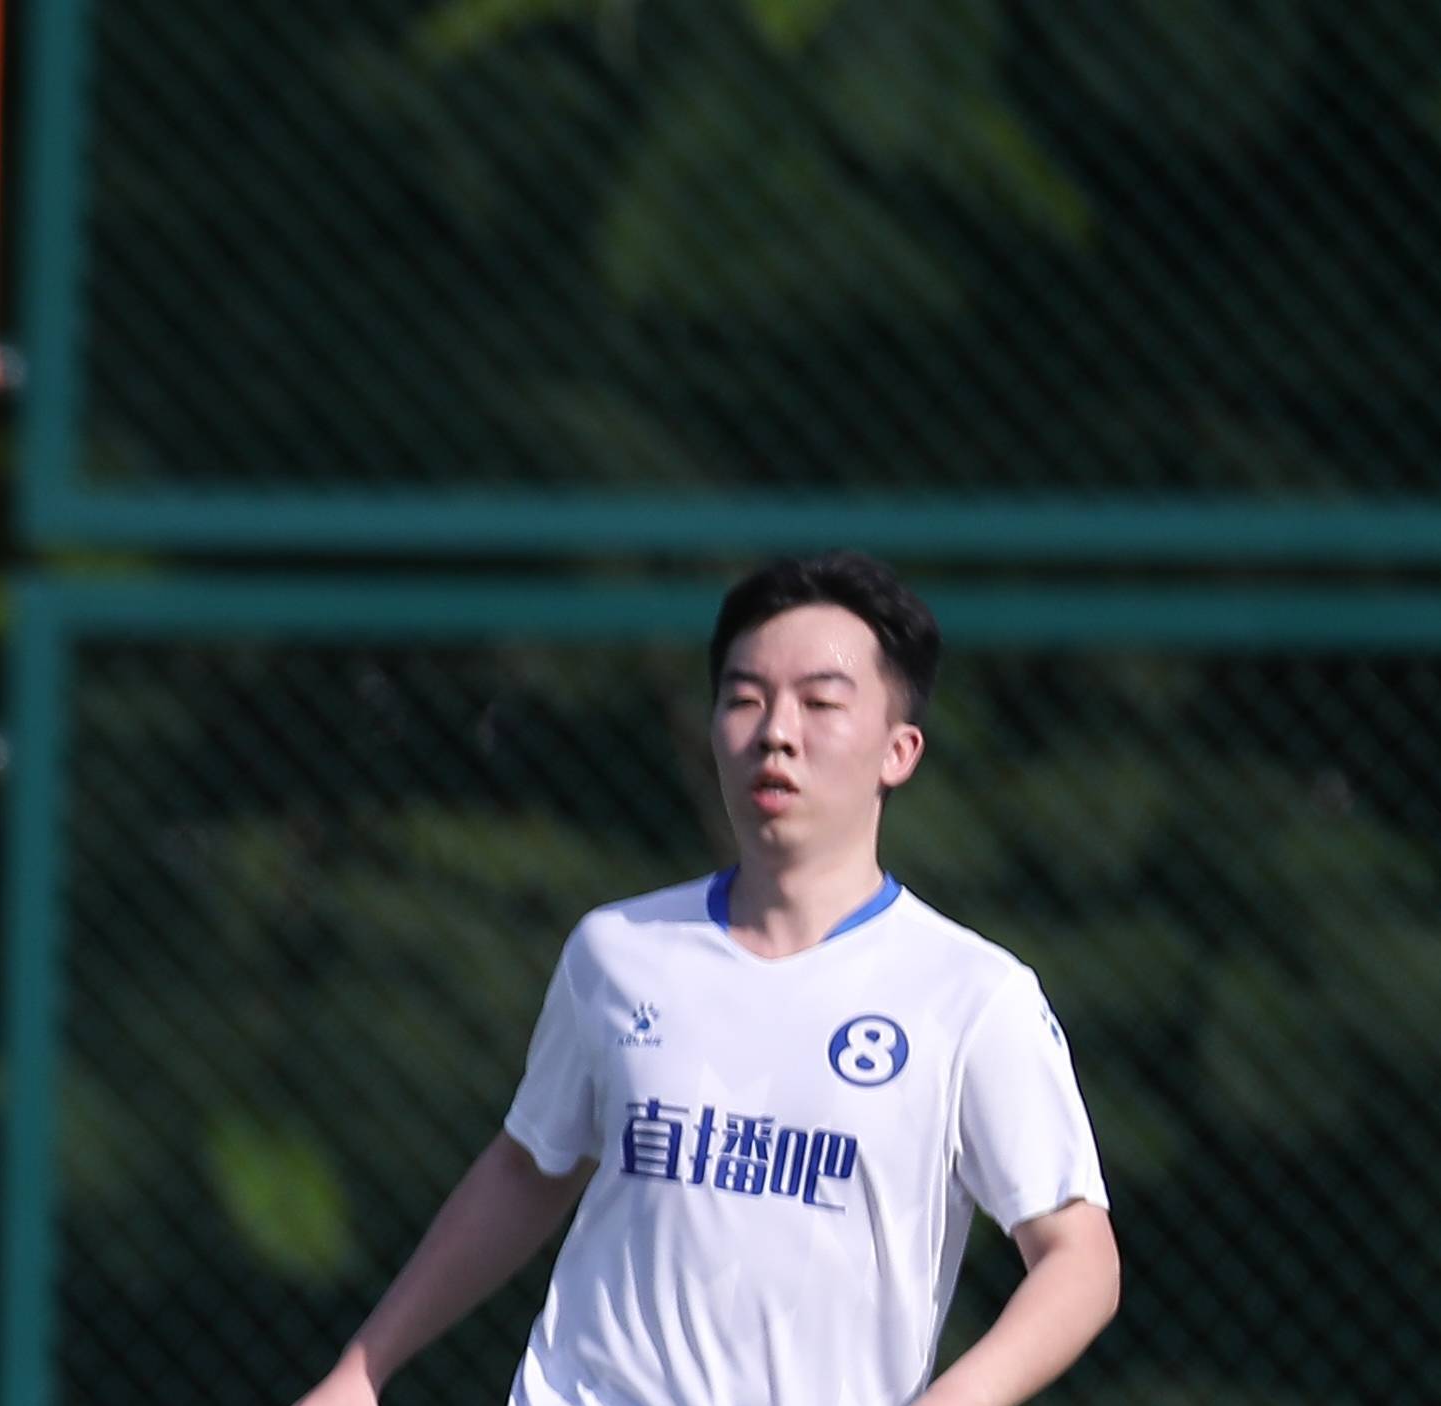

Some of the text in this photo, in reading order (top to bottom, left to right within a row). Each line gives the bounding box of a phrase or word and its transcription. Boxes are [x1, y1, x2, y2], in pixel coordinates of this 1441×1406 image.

[835, 1016, 898, 1084] 8
[620, 1098, 859, 1212] 直播吧
